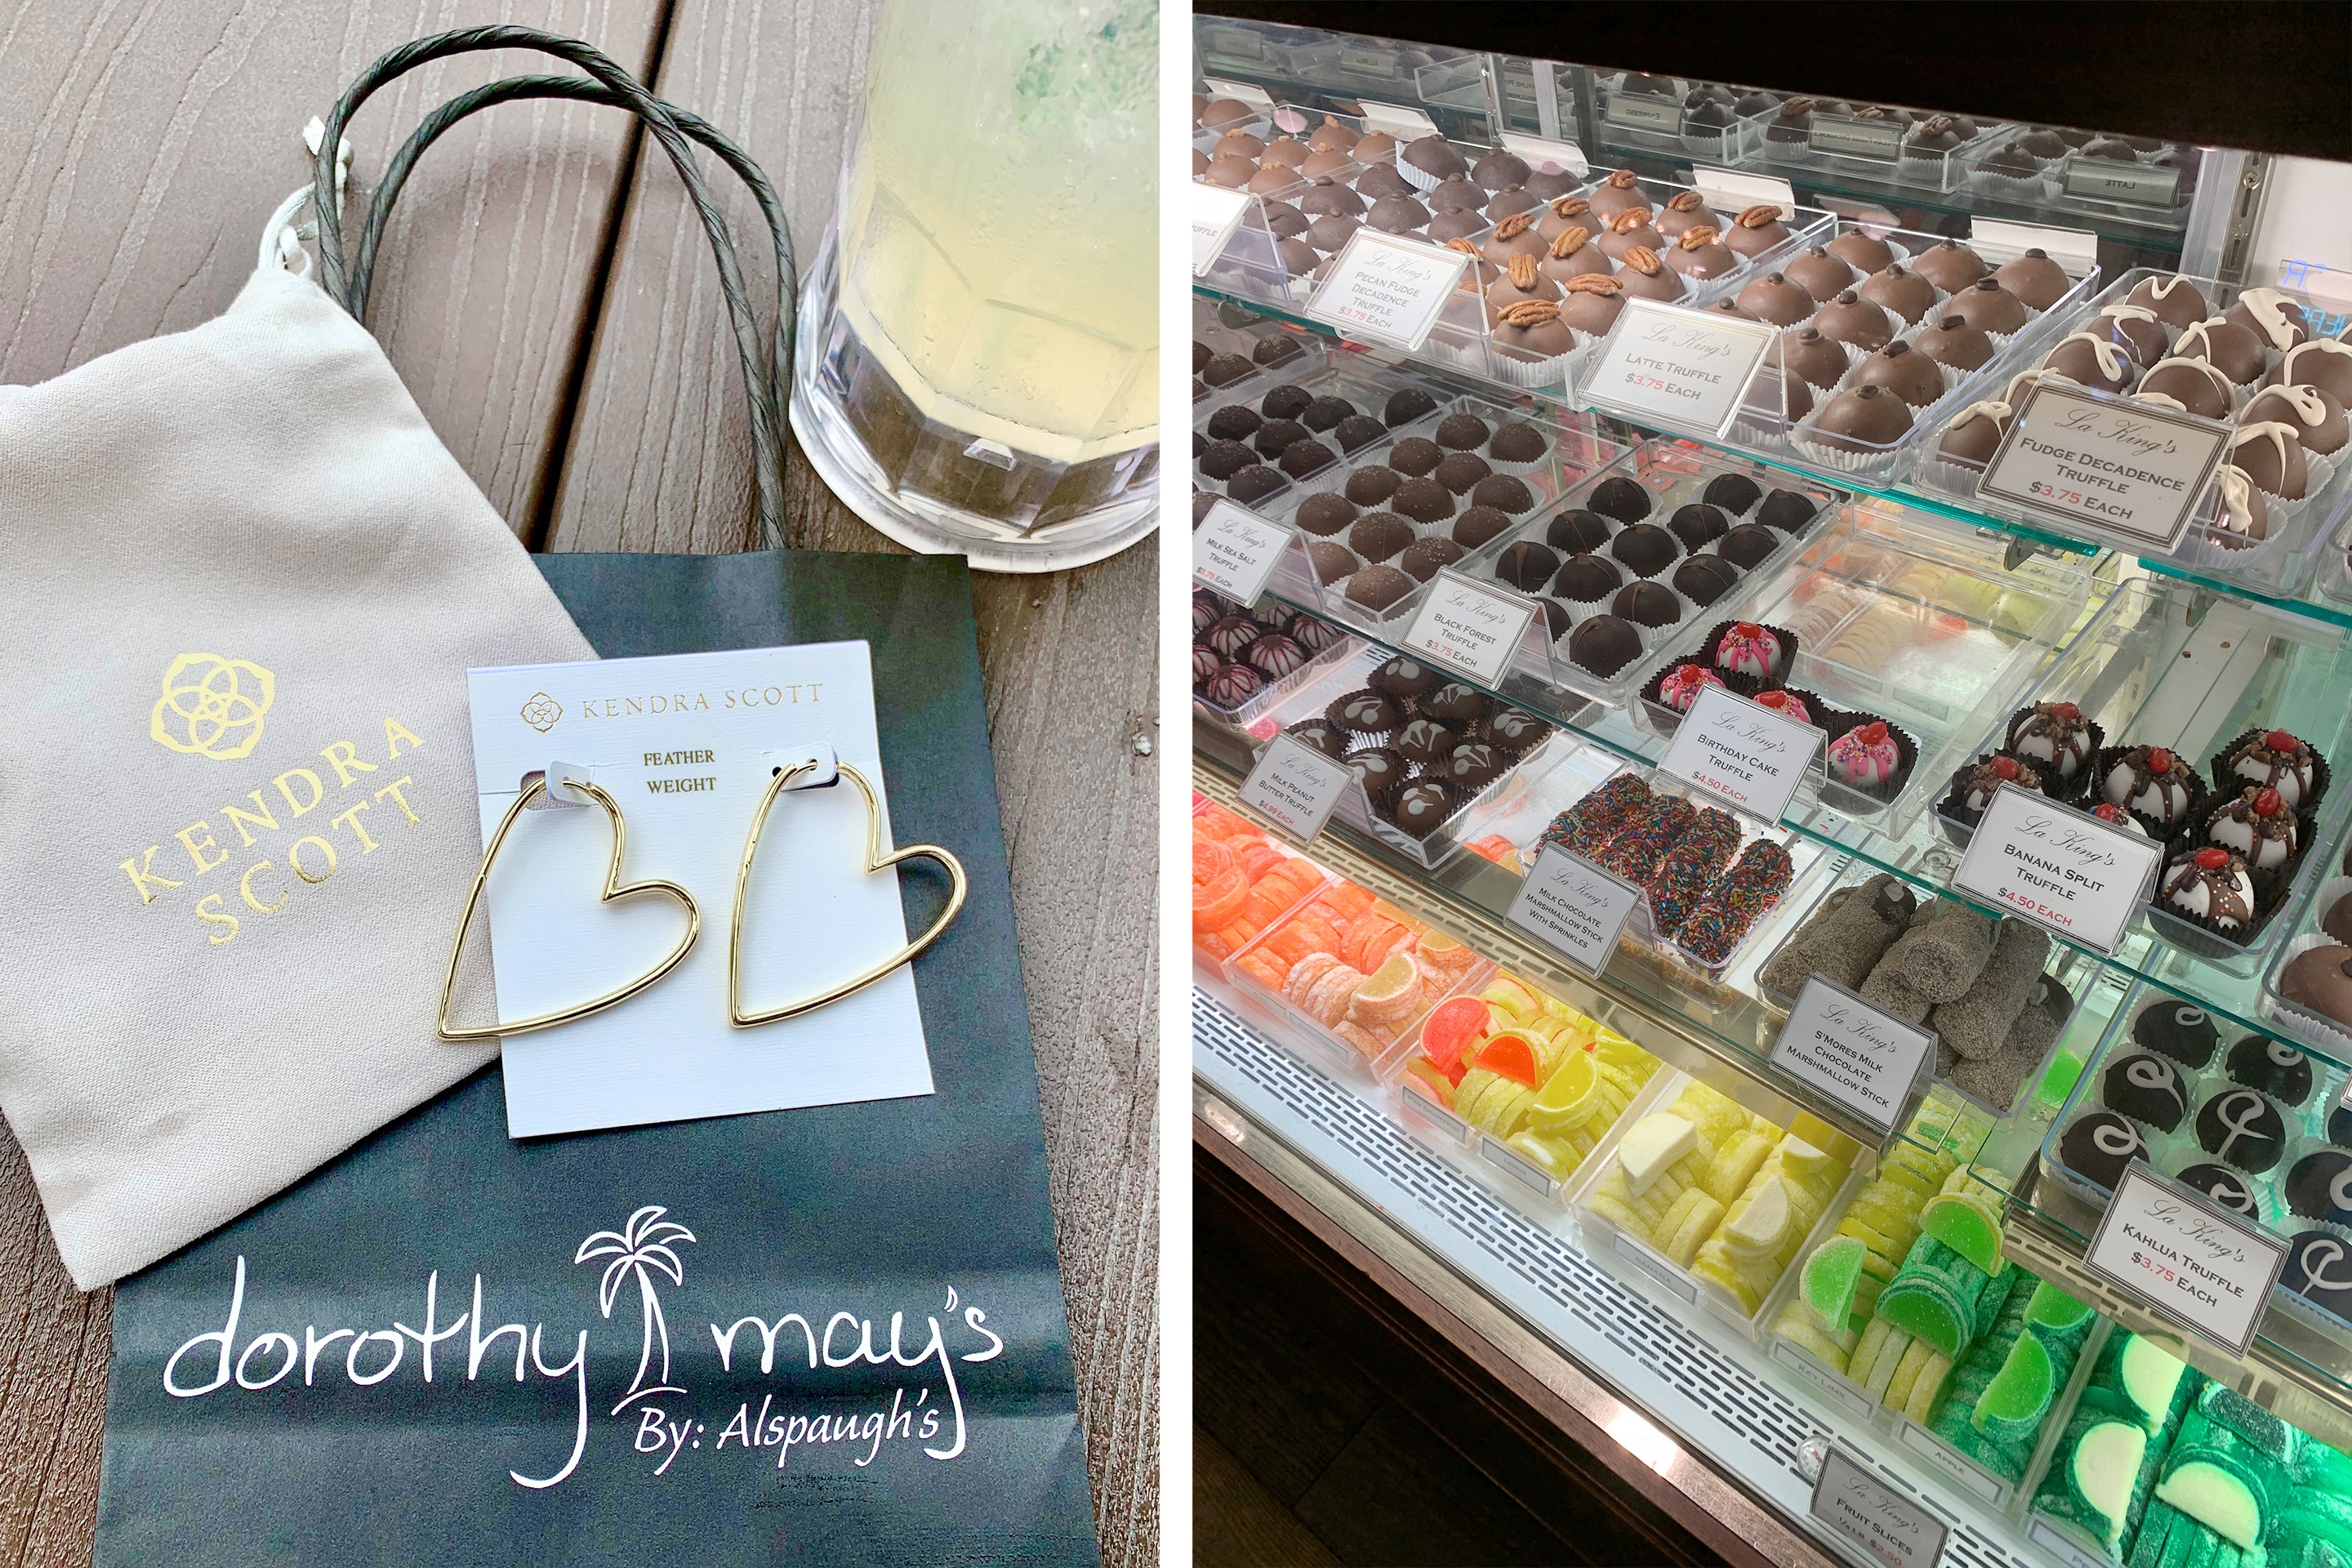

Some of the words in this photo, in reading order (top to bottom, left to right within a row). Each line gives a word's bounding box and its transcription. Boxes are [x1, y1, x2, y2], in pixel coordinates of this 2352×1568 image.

[1355, 271, 1390, 287] PECAN
[1388, 281, 1421, 297] FUDGE
[1364, 251, 1392, 268] La
[1388, 256, 1432, 283] King's
[1352, 284, 1409, 307] DECADENCE
[1353, 297, 1393, 316] TRUFFLE
[1338, 306, 1366, 321] $3.75
[1366, 315, 1392, 329] EACH
[1642, 323, 1677, 343] La
[1673, 330, 1732, 360] King's
[1624, 372, 1664, 390] $3.75
[1664, 383, 1702, 400] EACH
[1626, 353, 1664, 371] LATTE
[1667, 361, 1722, 384] TRUFFLE
[2055, 408, 2100, 433] La
[2097, 419, 2178, 456] King's
[2019, 438, 2076, 462] FUDGE
[2078, 454, 2185, 492] DECADENCE
[2055, 465, 2130, 494] TRUFFLE
[2029, 481, 2082, 505] $3.75
[2082, 497, 2133, 519] EACH
[1206, 538, 1225, 550] MILK
[1223, 546, 1237, 557] SEA
[1237, 553, 1257, 566] SALT
[1217, 519, 1239, 533] La
[1234, 526, 1266, 549] King's
[1196, 567, 1215, 580] $3.75
[1214, 576, 1233, 588] EACH
[1209, 552, 1239, 572] TRUFFLE
[1445, 590, 1470, 607] La
[1467, 599, 1506, 625] King's
[1434, 613, 1463, 631] BLACK
[1463, 626, 1497, 645] FOREST
[1441, 628, 1478, 650] TRUFFLE
[1425, 639, 1453, 657] $3.75
[1453, 651, 1477, 667] EACH
[582, 692, 710, 720] KENDRA
[724, 684, 824, 710] SCOTT
[1711, 711, 1741, 730] La
[1737, 723, 1786, 753] King's
[643, 749, 716, 767] FEATHER
[1279, 753, 1300, 768] La
[1295, 763, 1326, 787] King's
[1697, 733, 1748, 762] BIRTHDAY
[1749, 757, 1780, 777] CAKE
[1708, 755, 1753, 782] TRUFFLE
[645, 777, 717, 795] WEIGHT
[1258, 780, 1285, 800] BUTTER
[1284, 795, 1314, 817] TRUFFLE
[1271, 773, 1290, 787] MILK
[1287, 782, 1315, 803] PEANUT
[1691, 771, 1721, 790] $4.50
[1721, 784, 1748, 803] EACH
[118, 715, 426, 907] KENDRA
[1258, 800, 1277, 815] $4.99
[1276, 812, 1294, 826] EACH
[2014, 816, 2053, 839] La
[2050, 830, 2116, 866] King's
[194, 774, 422, 947] SCOTT
[2003, 844, 2062, 876] BANANA
[2064, 869, 2105, 893] SPLIT
[1550, 867, 1574, 886] La
[1570, 880, 1609, 908] King's
[2016, 867, 2077, 901] TRUFFLE
[1526, 893, 1585, 929] MARSHMALLOW
[1581, 926, 1604, 943] STICK
[1539, 888, 1557, 902] MILK
[1557, 898, 1602, 928] CHOCOLATE
[1997, 887, 2036, 910] $4.50
[2036, 905, 2073, 927] EACH
[1529, 909, 1548, 925] WITH
[1548, 921, 1588, 949] SPRINKLES
[1819, 1004, 1850, 1026] La
[1846, 1018, 1897, 1054] King's
[1814, 1046, 1873, 1083] CHOCOLATE
[1815, 1031, 1859, 1058] S'MORES
[1858, 1054, 1883, 1073] MILK
[1786, 1045, 1861, 1091] MARSHMALLOW
[1860, 1087, 1890, 1108] STICK
[2143, 1200, 2181, 1225] La
[2178, 1218, 2246, 1263] King's
[2123, 1223, 2179, 1263] KAHLUA
[2182, 1254, 2245, 1299] TRUFFLE
[2131, 1251, 2176, 1283] $3.75
[2176, 1276, 2218, 1308] EACH
[163, 1254, 588, 1490] dorothy
[710, 1284, 1005, 1460] may's
[634, 1405, 706, 1477] By:
[715, 1388, 941, 1469] Alspaugh's
[1935, 1452, 1966, 1475] APPLE
[1842, 1477, 1869, 1499] La
[1869, 1496, 1920, 1534] King's
[1837, 1498, 1871, 1526] FRUIT
[1871, 1522, 1913, 1556] SLICES
[1869, 1539, 1901, 1566] $2.50
